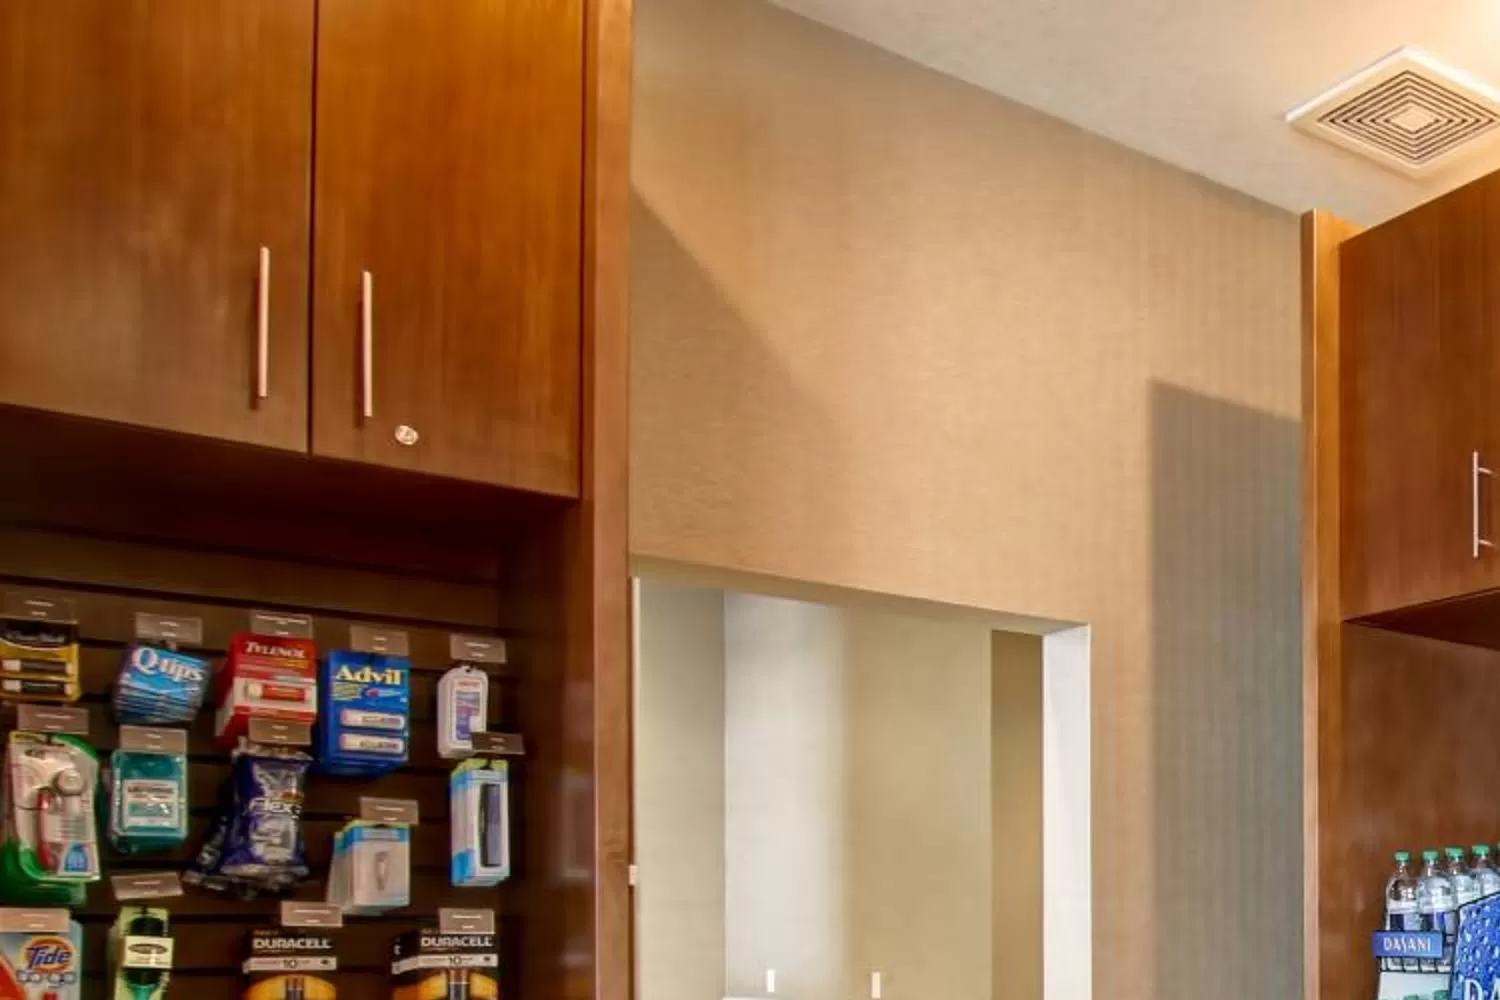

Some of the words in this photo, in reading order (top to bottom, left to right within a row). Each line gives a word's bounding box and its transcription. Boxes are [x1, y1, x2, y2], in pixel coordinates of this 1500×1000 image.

[131, 647, 204, 682] Q-tips
[336, 665, 401, 685] Advil
[253, 937, 332, 950] DURACELL
[420, 935, 493, 948] DURACELL
[1383, 935, 1432, 952] DASANI
[27, 946, 72, 968] Tide
